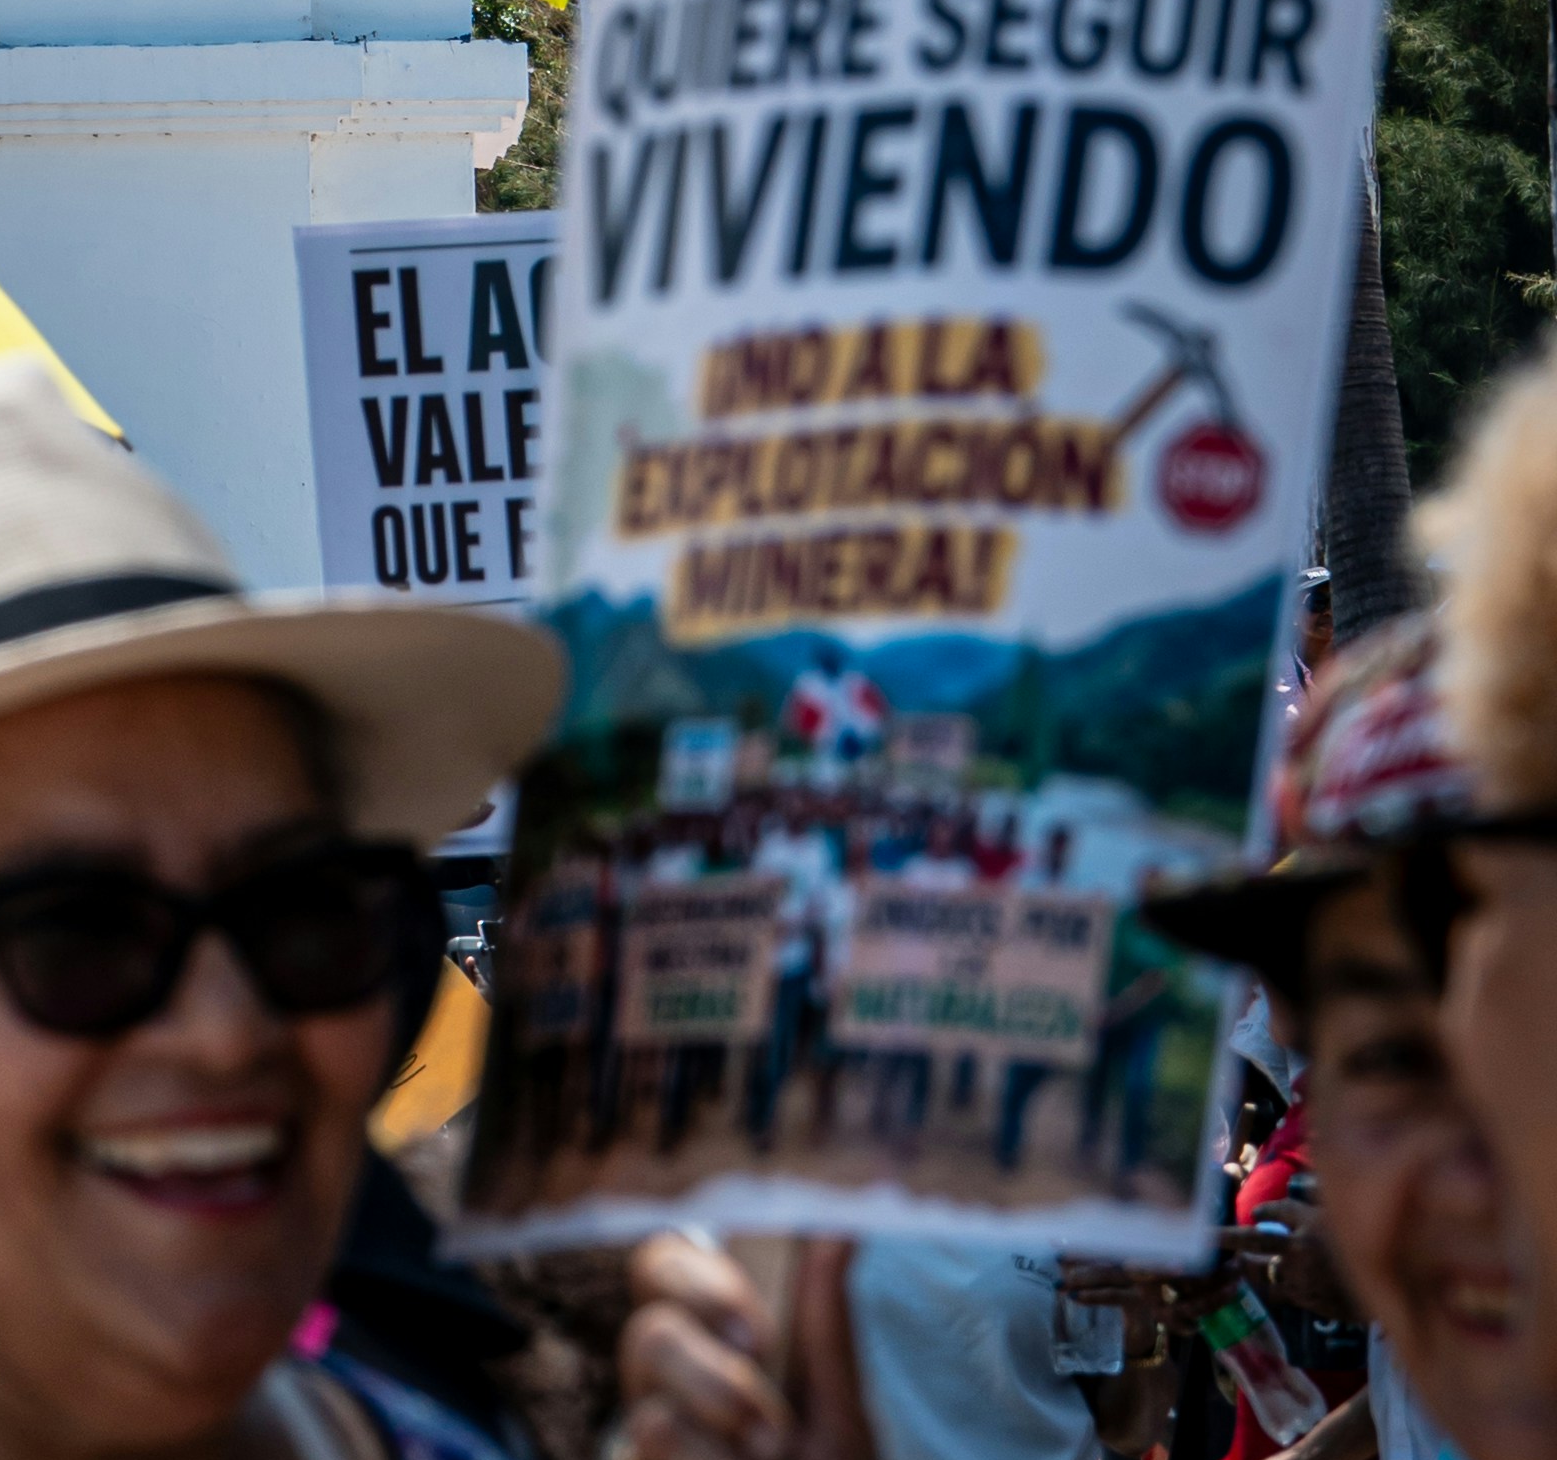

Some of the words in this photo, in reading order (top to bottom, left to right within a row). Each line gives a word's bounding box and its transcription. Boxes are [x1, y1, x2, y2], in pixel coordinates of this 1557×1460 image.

[583, 95, 1299, 310] VIVIENDO
[351, 266, 445, 378] EL
[915, 308, 1019, 398] LA
[371, 499, 485, 591] QUE
